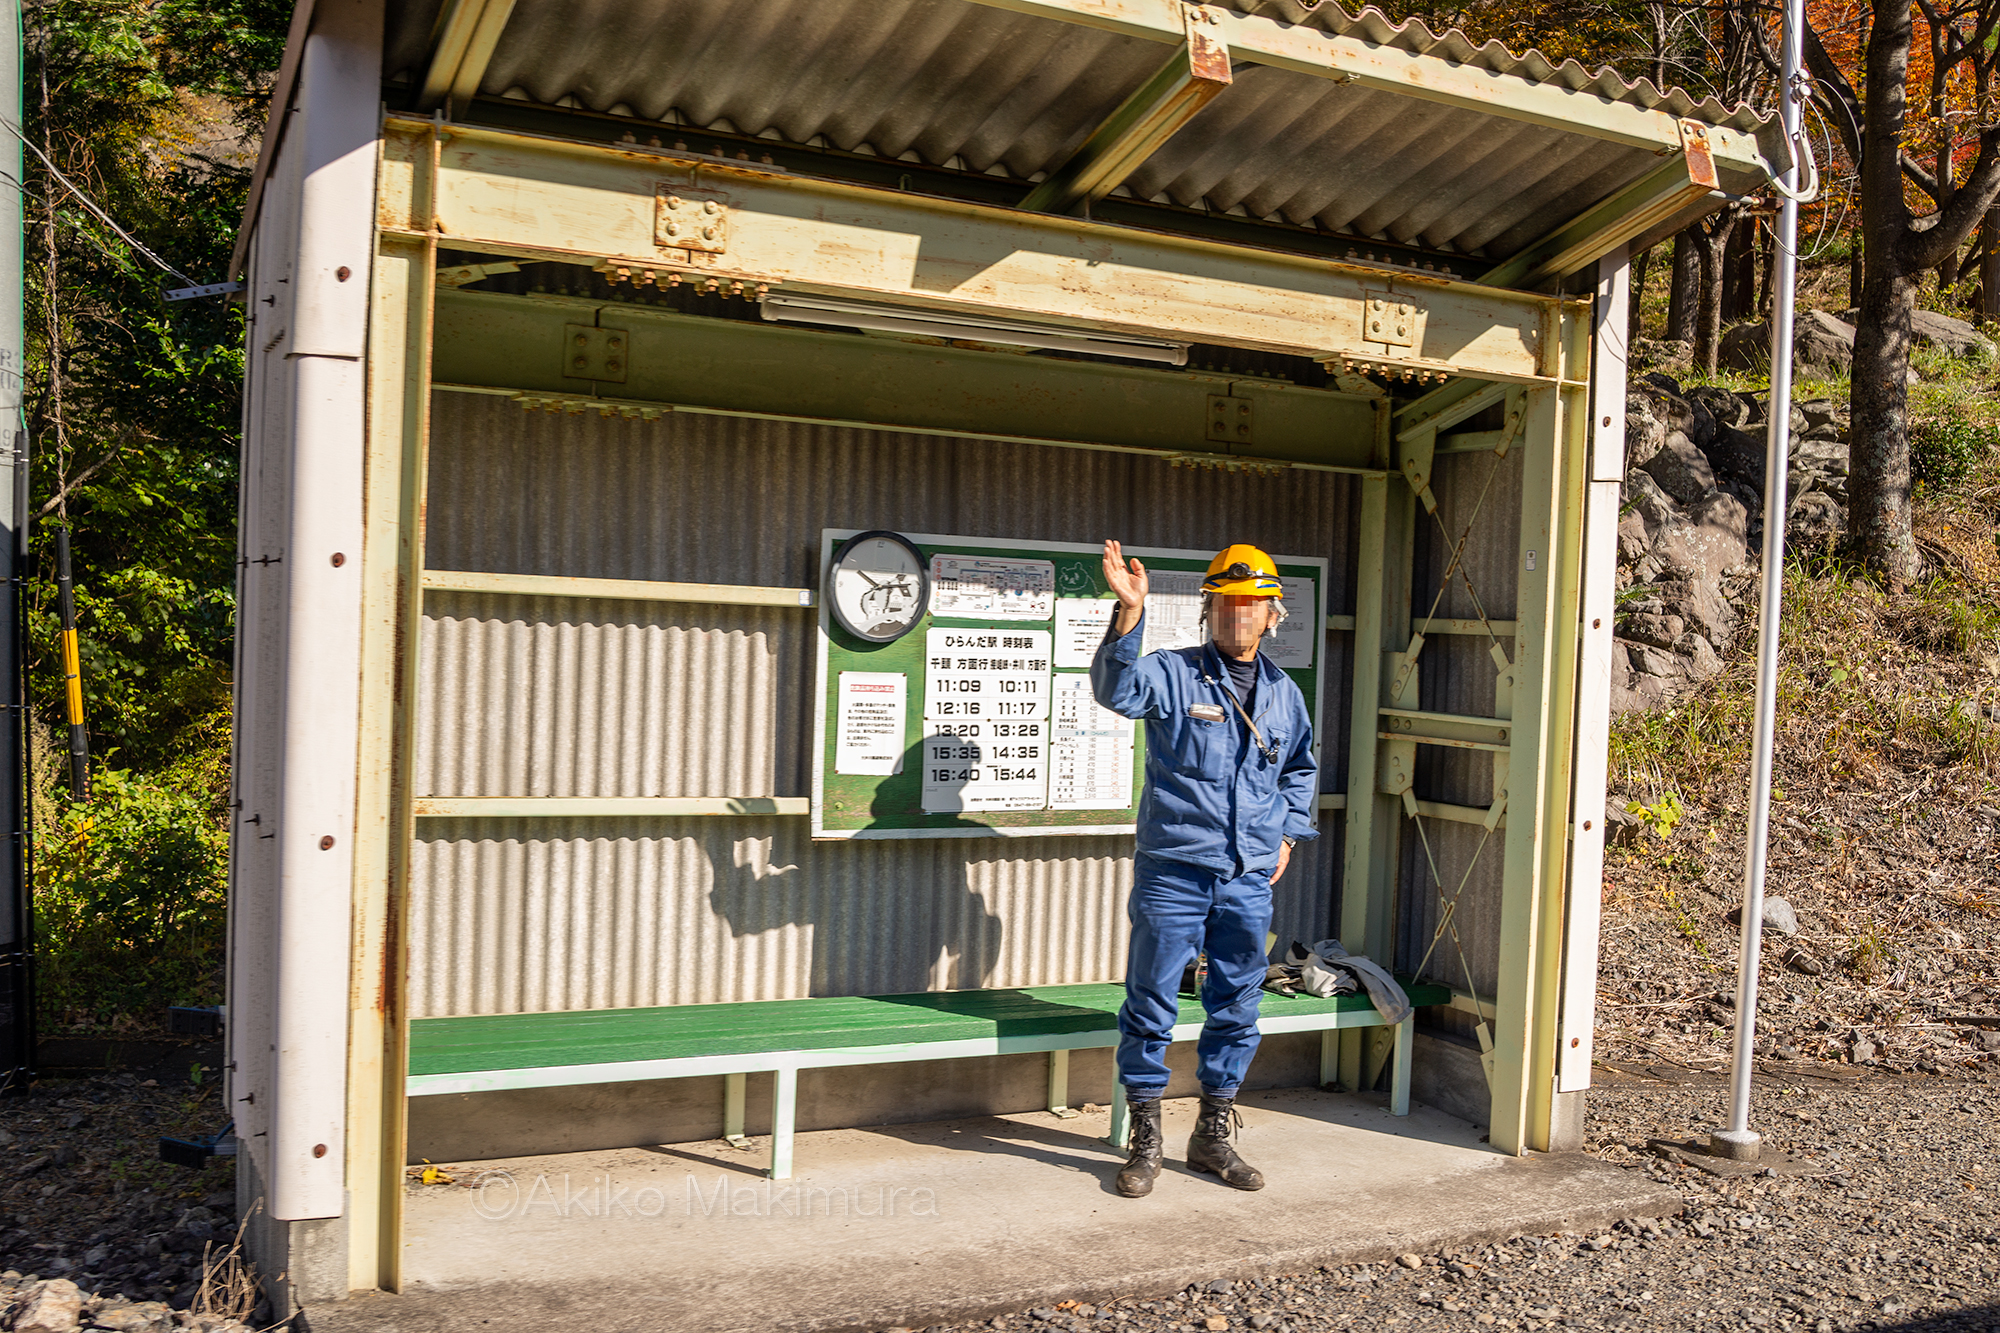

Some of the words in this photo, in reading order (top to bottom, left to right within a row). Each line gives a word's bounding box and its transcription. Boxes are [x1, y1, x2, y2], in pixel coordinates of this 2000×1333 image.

[945, 636, 998, 648] ひらんだ駅
[1003, 637, 1034, 649] 時刻表
[930, 658, 952, 669] 千頭
[957, 658, 988, 670] 方面行
[937, 680, 981, 692] 11:09
[999, 681, 1036, 693] 10:11
[936, 702, 980, 715] 12:16
[998, 702, 1037, 715] 11:17
[935, 725, 980, 737] 13:20
[993, 725, 1039, 737] 13:28
[932, 747, 980, 759] 15:35
[992, 747, 1039, 759] 14:35
[931, 769, 980, 782] 16:40
[993, 768, 1037, 781] 15:44
